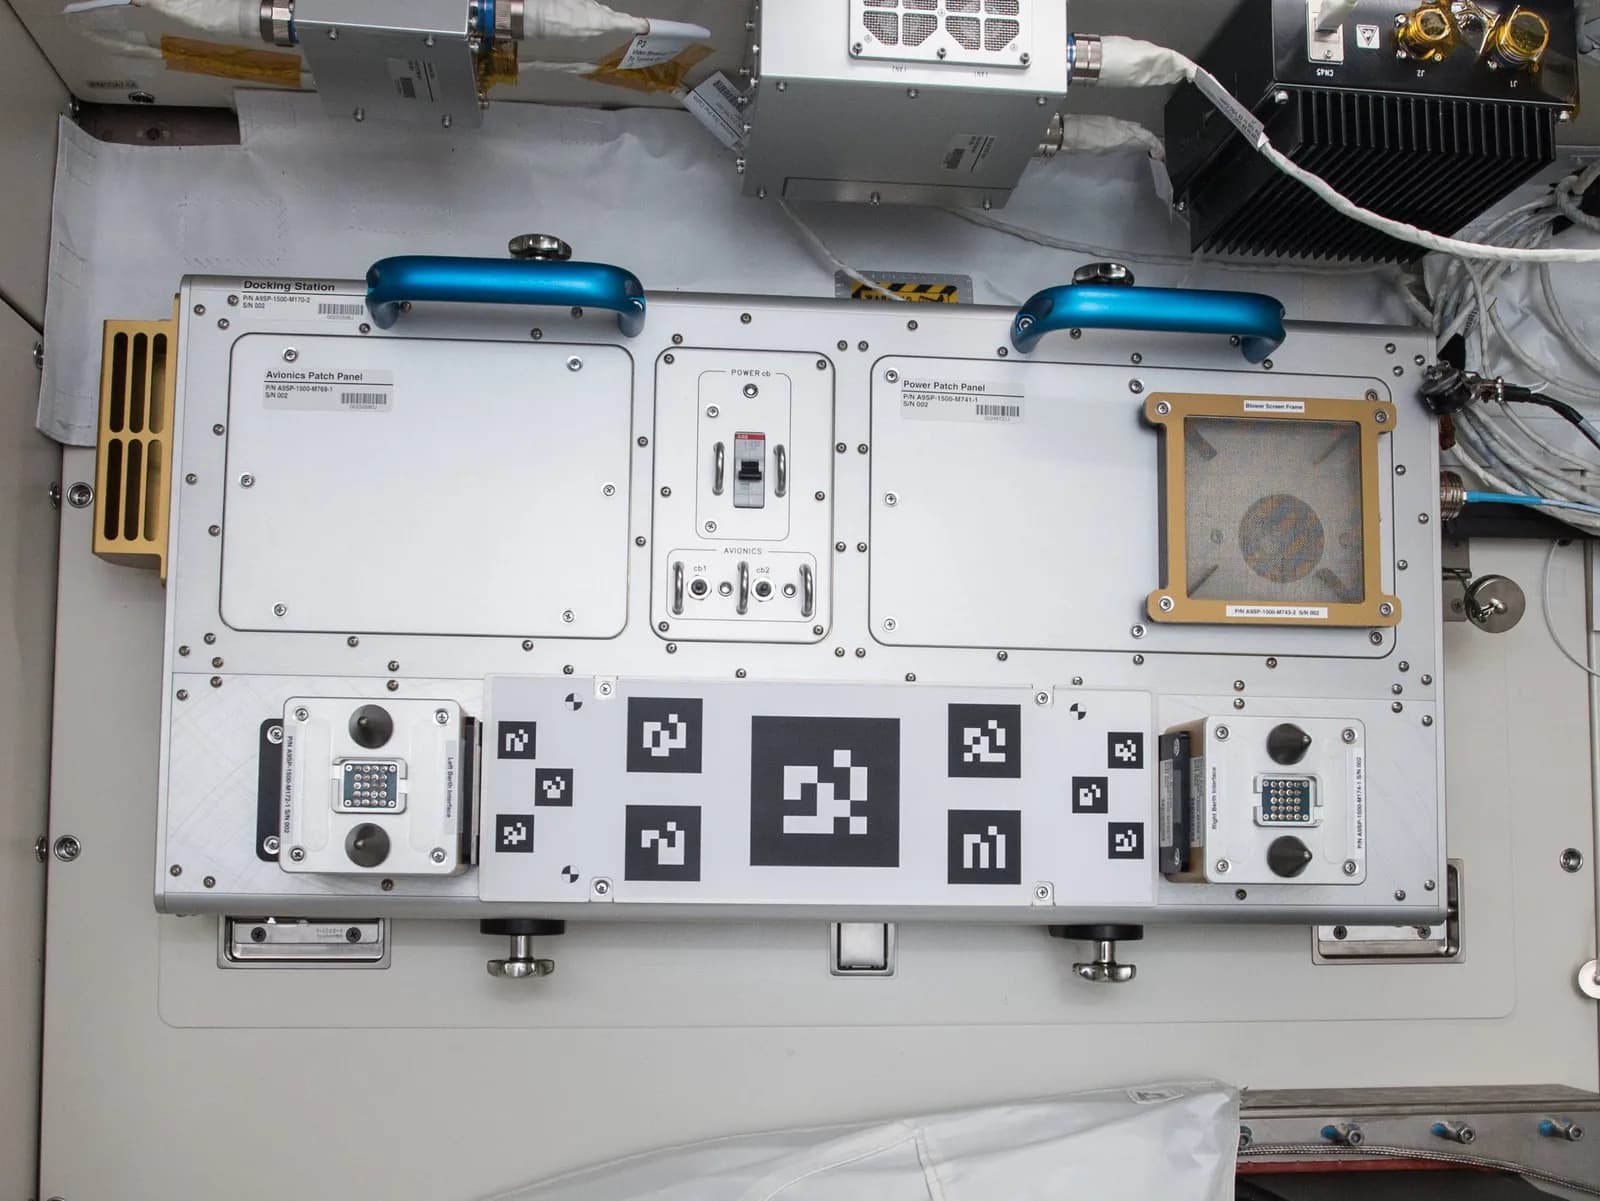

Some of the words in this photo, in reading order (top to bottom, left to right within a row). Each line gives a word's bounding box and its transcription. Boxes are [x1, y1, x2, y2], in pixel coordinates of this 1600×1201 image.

[1416, 69, 1425, 77] J2
[244, 280, 291, 291] Docking
[295, 282, 335, 291] Station
[266, 371, 306, 380] Avionics
[309, 372, 335, 380] Patch
[337, 372, 363, 381] Panel
[903, 380, 931, 389] Power
[934, 382, 959, 390] Patch
[961, 383, 985, 392] Panel
[723, 547, 762, 555] AVIONICS
